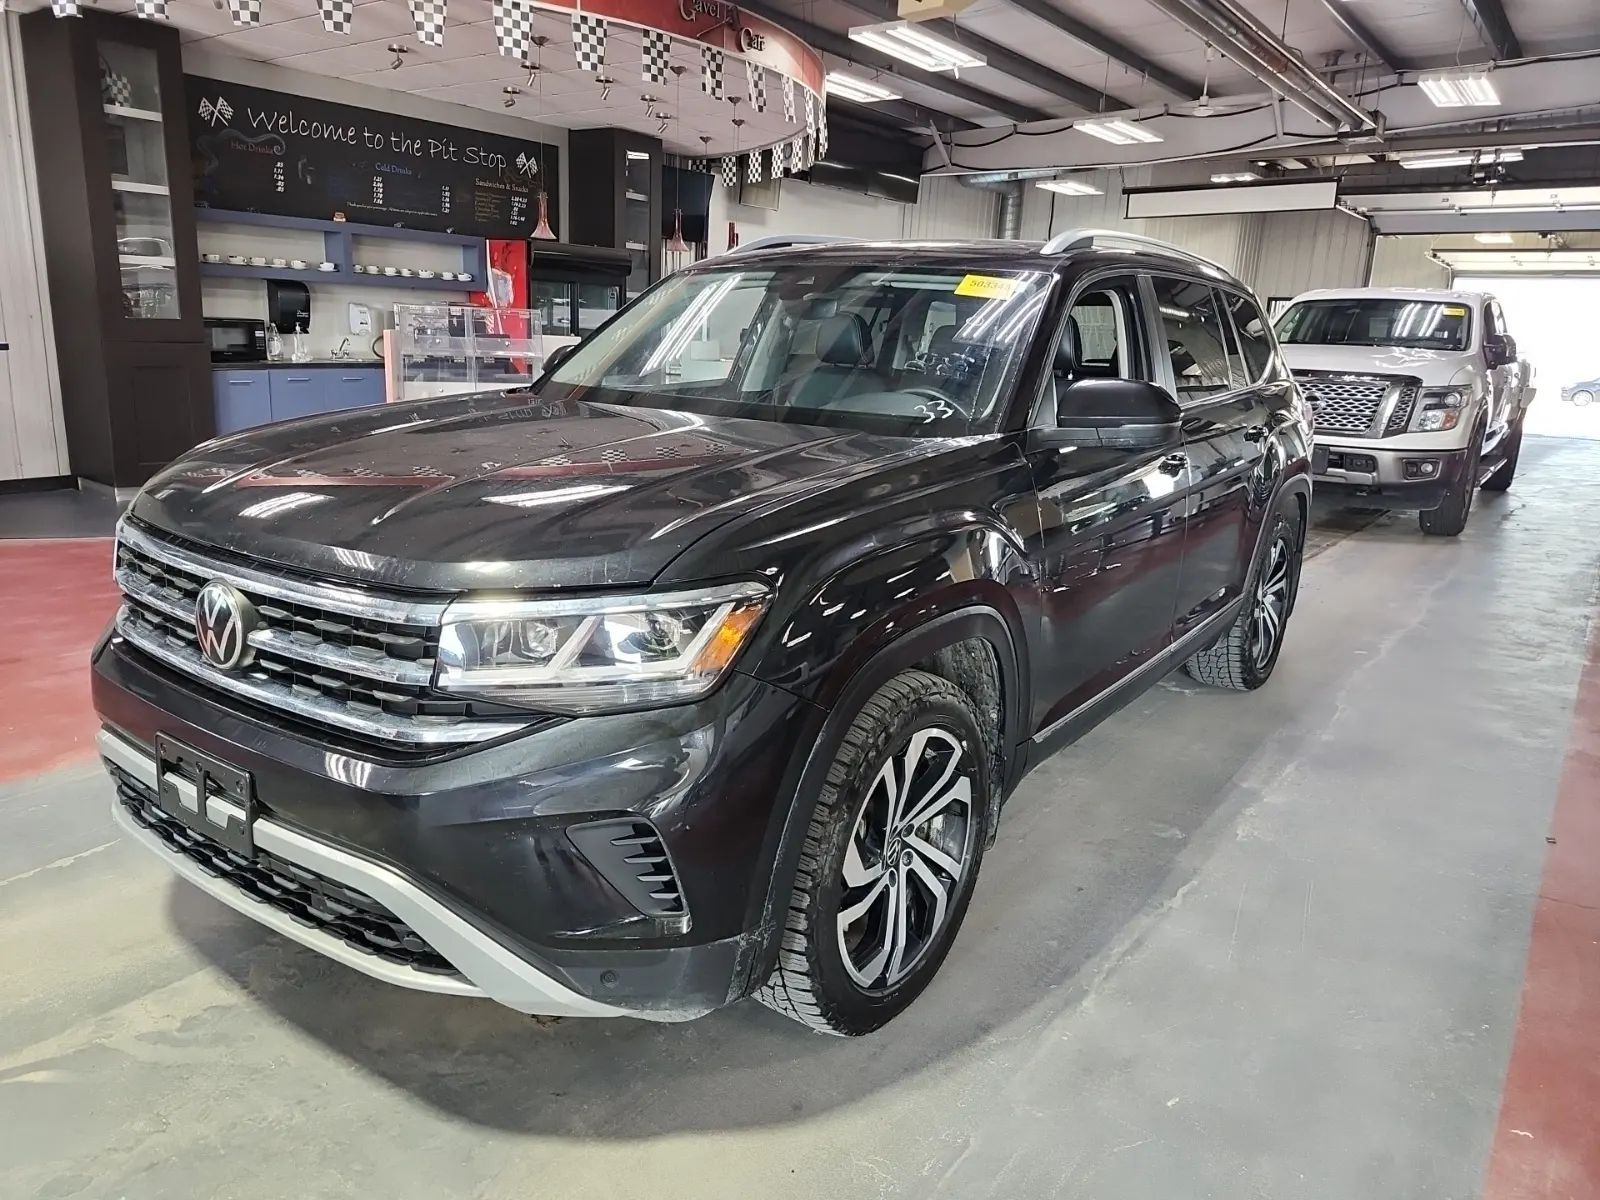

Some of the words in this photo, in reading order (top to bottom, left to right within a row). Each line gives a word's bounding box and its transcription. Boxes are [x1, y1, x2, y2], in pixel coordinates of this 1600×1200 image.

[679, 0, 720, 23] Gavel
[230, 140, 247, 150] Hot
[247, 107, 357, 145] Welcome
[363, 126, 384, 150] to
[390, 131, 422, 156] the
[427, 138, 458, 162] Pit
[463, 146, 507, 177] Stop
[375, 162, 390, 172] Cold
[391, 164, 412, 175] Drinks
[475, 178, 505, 190] Sandwiches
[511, 184, 529, 193] Snacks
[913, 400, 954, 424] 33
